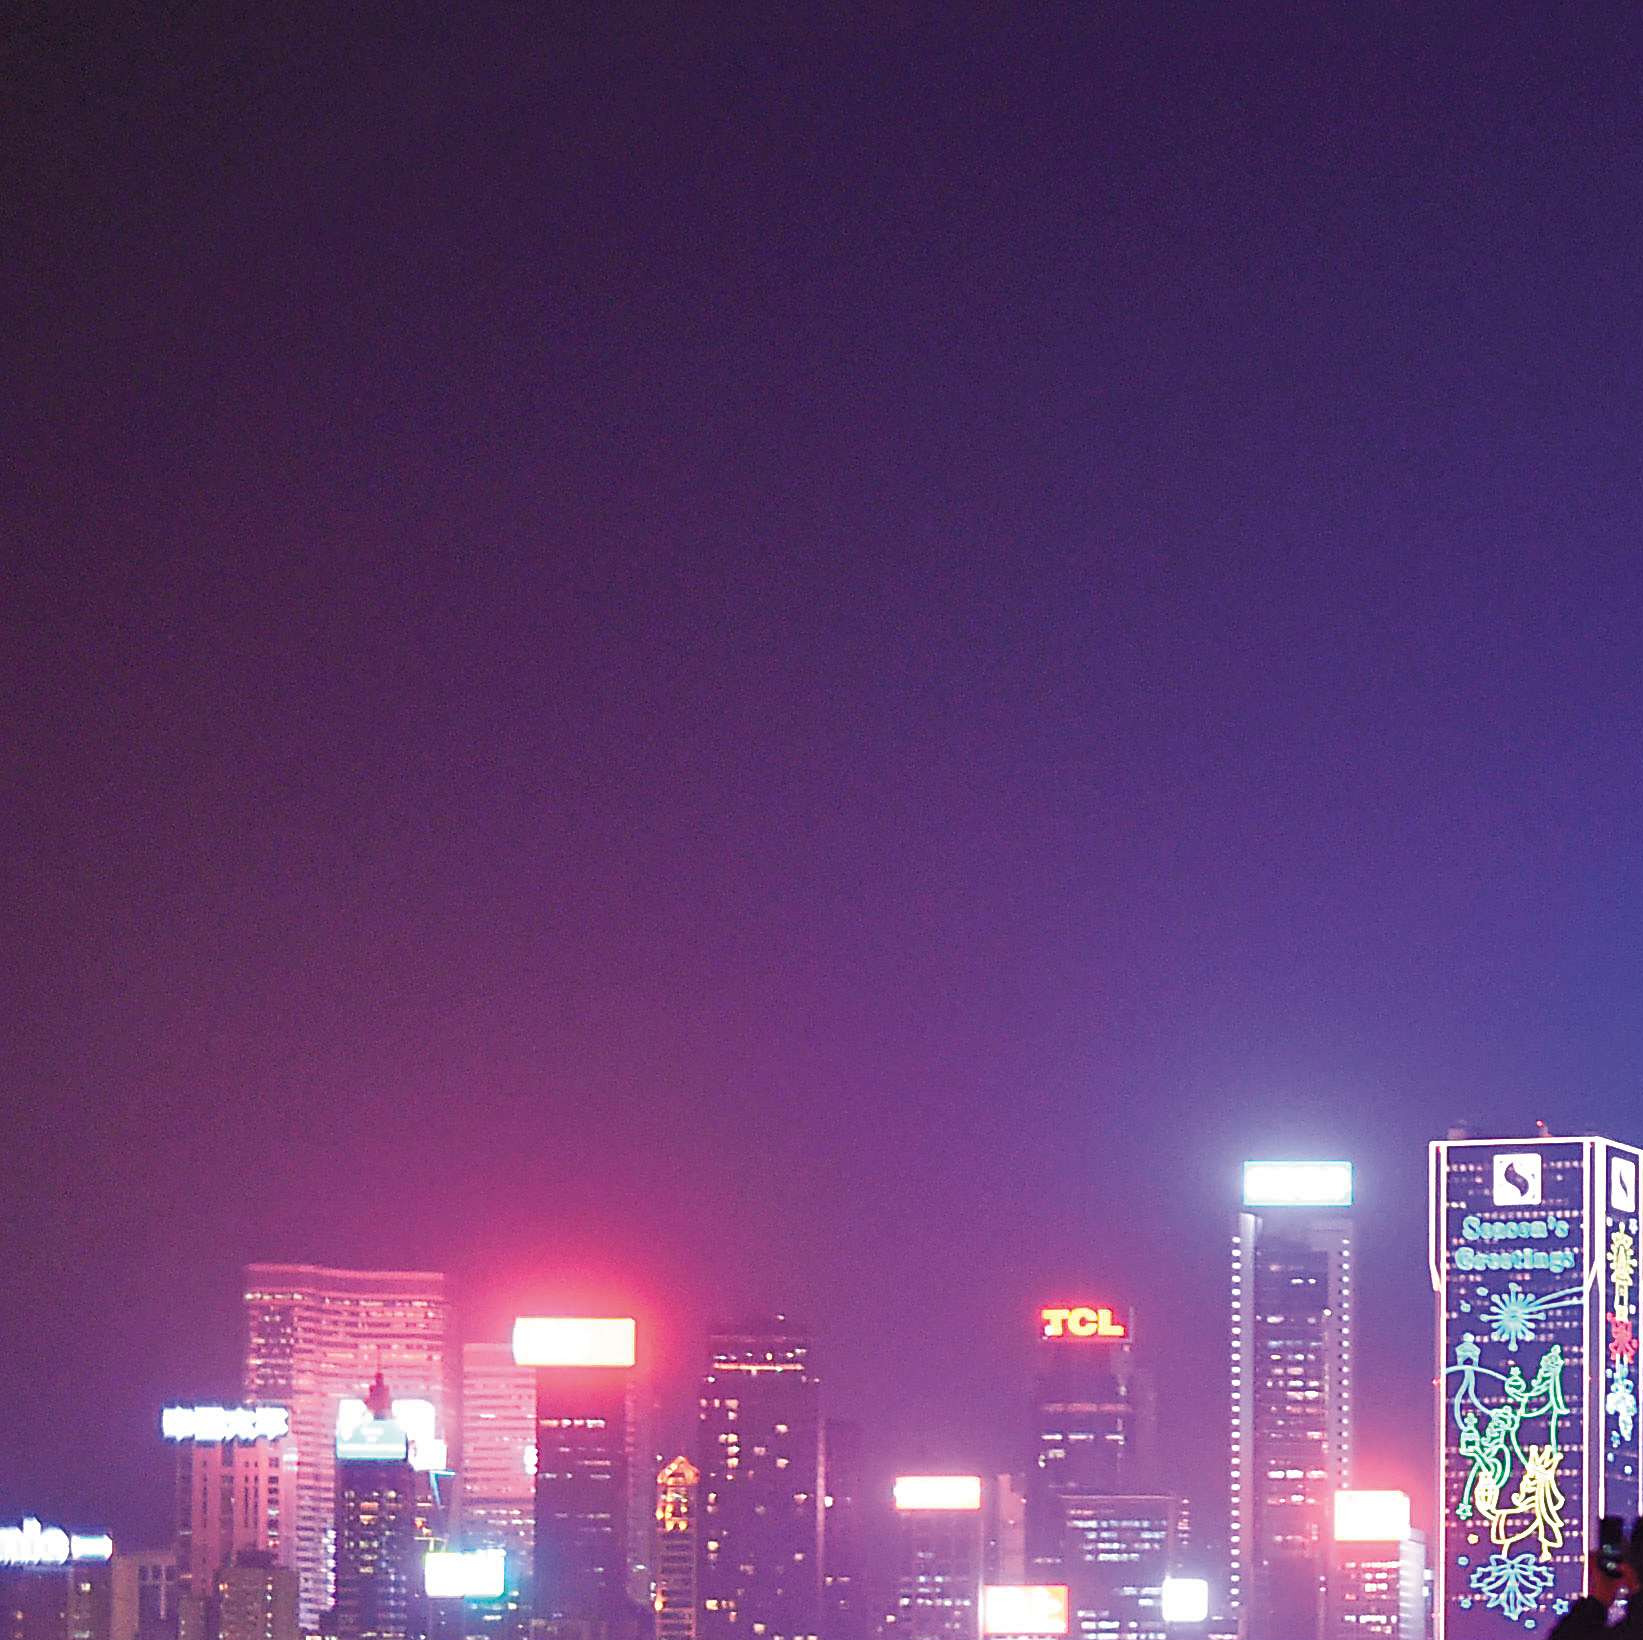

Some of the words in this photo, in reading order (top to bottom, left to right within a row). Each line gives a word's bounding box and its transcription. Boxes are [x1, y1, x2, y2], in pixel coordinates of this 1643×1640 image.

[1462, 1216, 1569, 1240] Season's
[1455, 1247, 1575, 1273] Greetings
[1043, 1307, 1125, 1336] TCL
